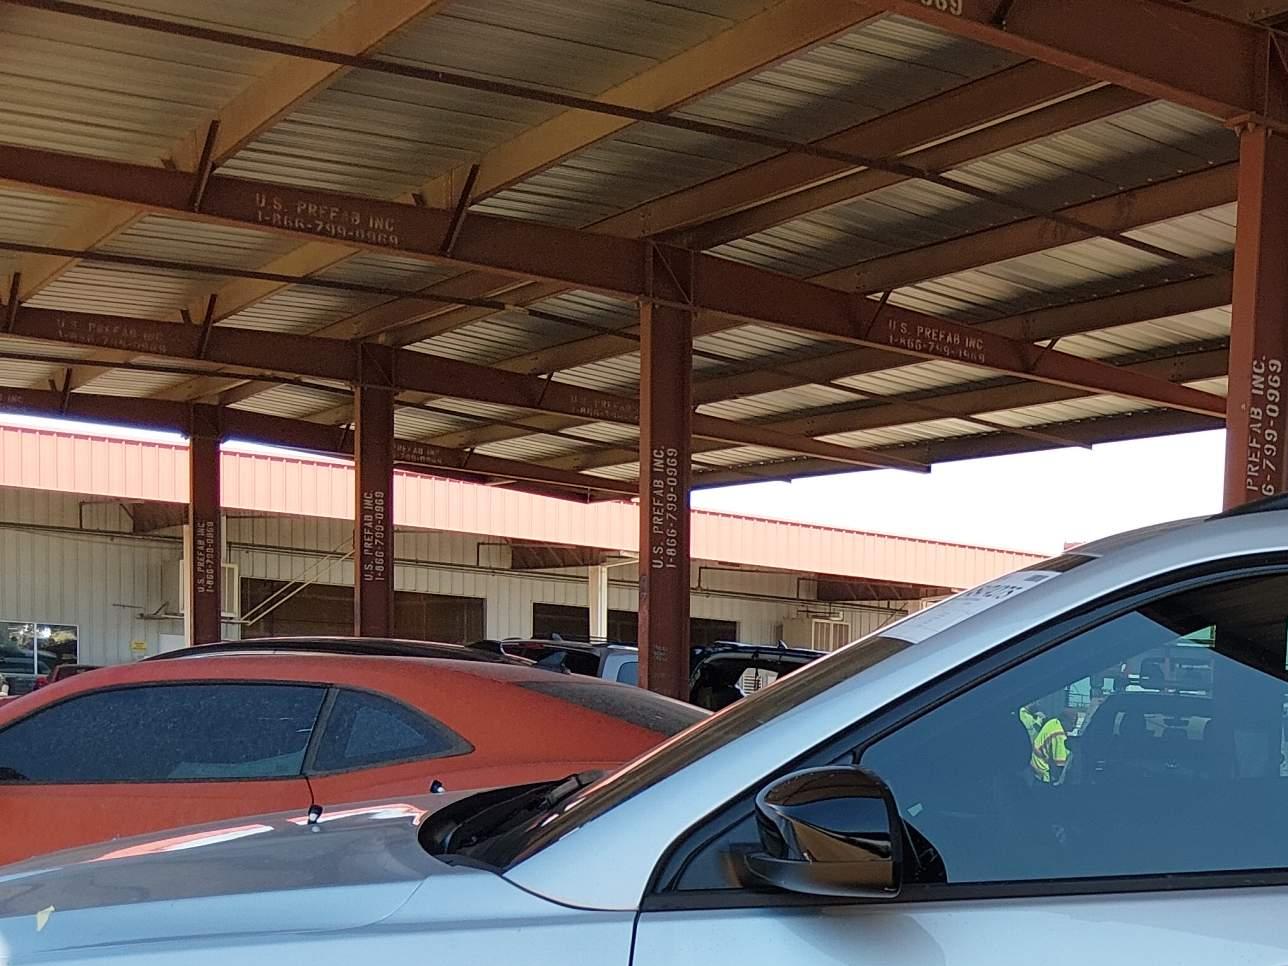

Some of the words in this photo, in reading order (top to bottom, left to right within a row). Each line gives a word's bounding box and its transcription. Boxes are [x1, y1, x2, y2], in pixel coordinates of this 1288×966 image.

[296, 200, 361, 226] PREFAB
[917, 325, 961, 346] PREFAB
[1251, 355, 1266, 396] INC.
[653, 446, 665, 472] INC.
[1246, 406, 1263, 492] PREFAB
[652, 479, 664, 534] PREFAB
[665, 448, 678, 568] 1-866-799-0969
[363, 514, 374, 555] PREFAB
[652, 542, 664, 569] U.S.
